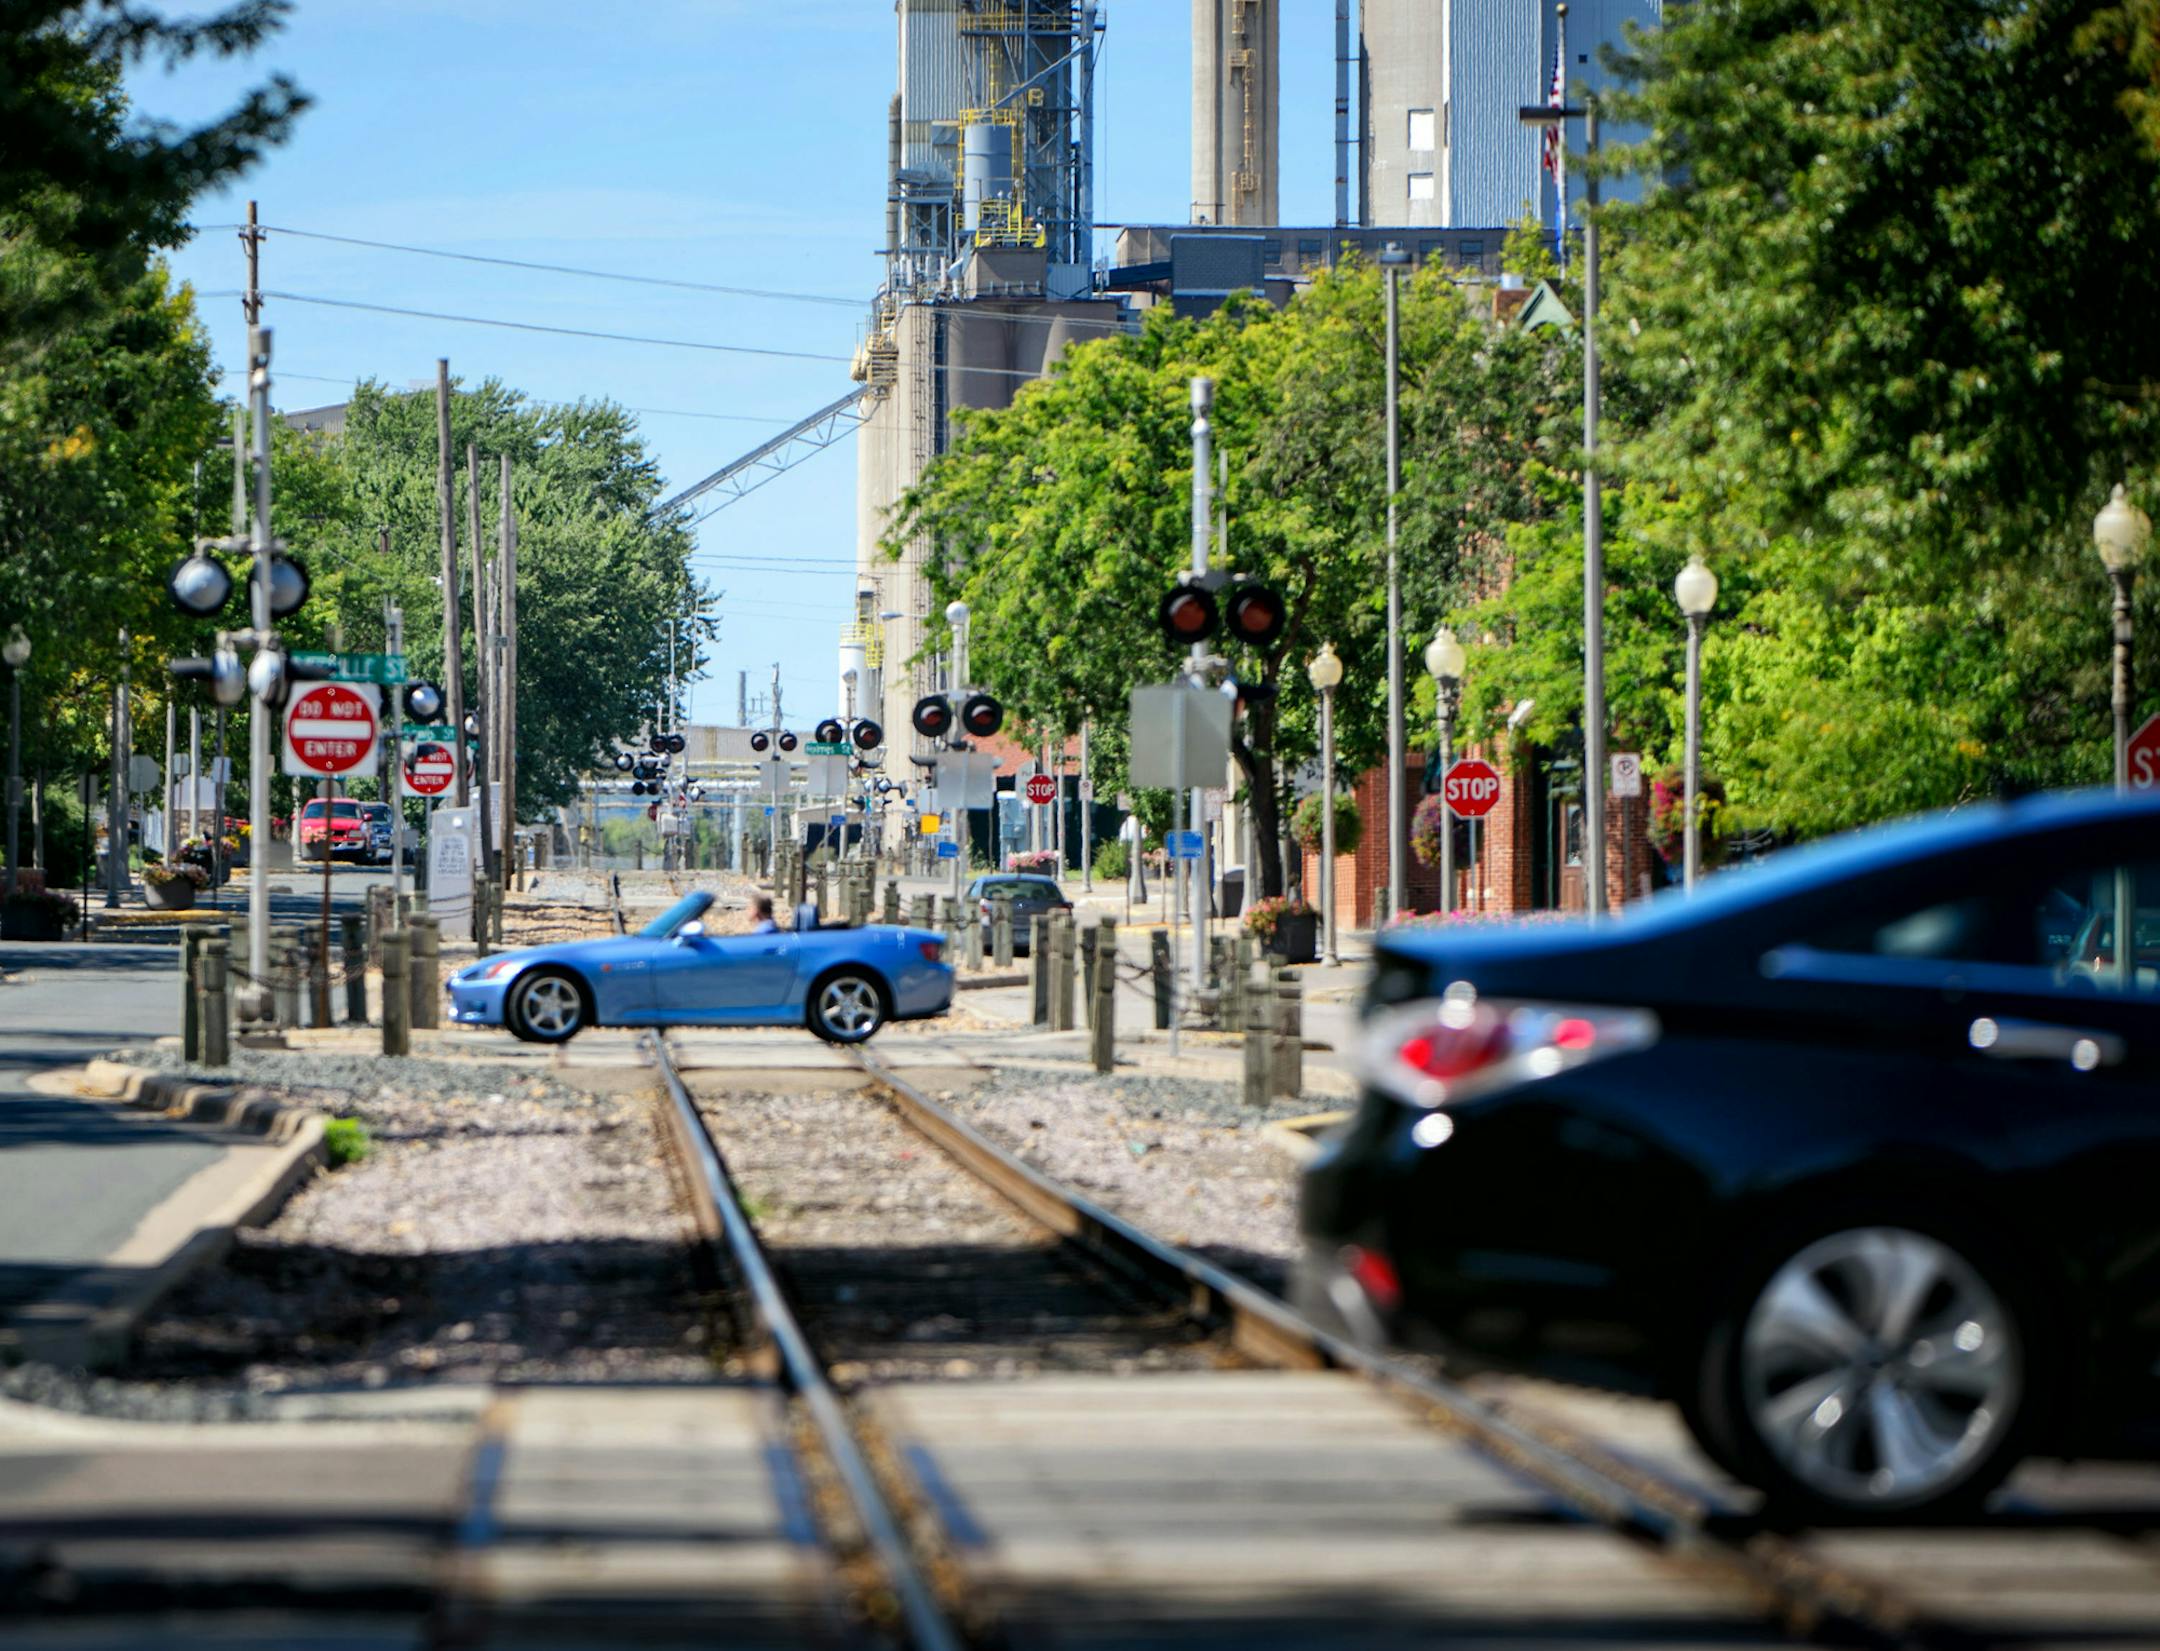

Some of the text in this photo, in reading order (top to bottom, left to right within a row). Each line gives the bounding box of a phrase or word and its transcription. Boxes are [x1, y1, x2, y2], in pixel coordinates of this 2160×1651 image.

[299, 701, 362, 718] DO NOT
[304, 741, 357, 758] ENTER
[413, 775, 445, 785] ENTER
[1447, 777, 1497, 800] STOP
[1027, 783, 1055, 797] STOP
